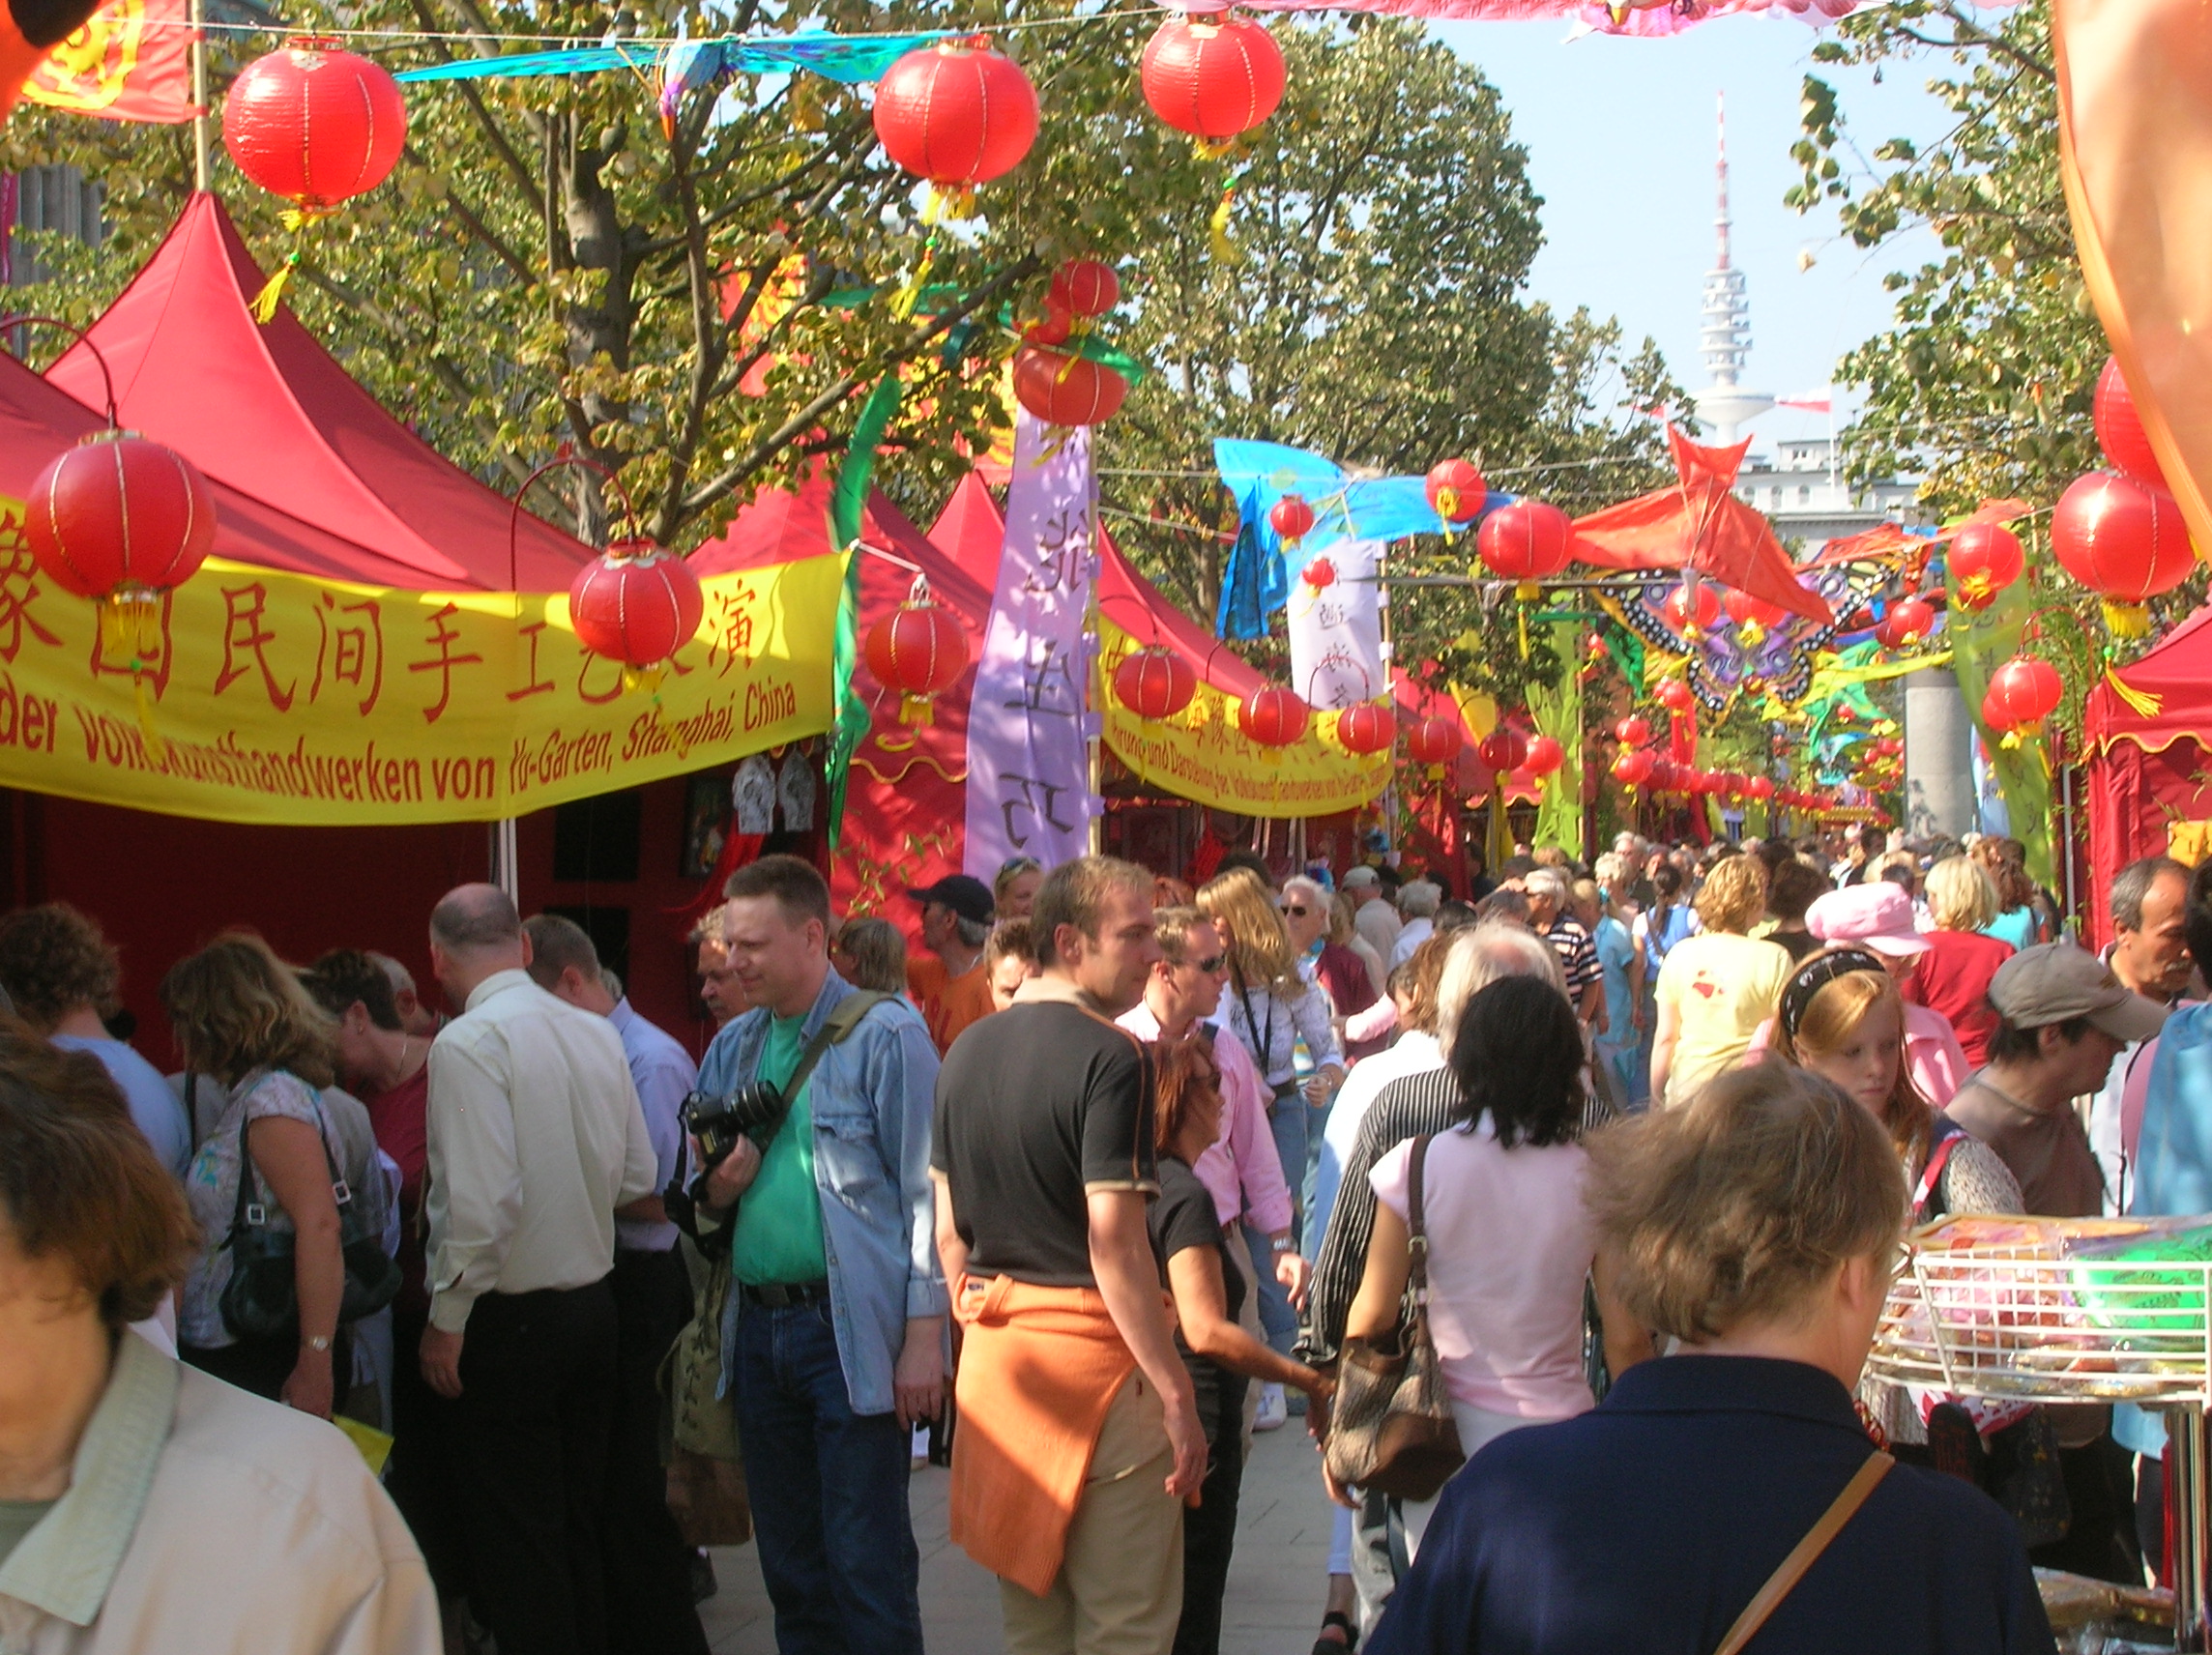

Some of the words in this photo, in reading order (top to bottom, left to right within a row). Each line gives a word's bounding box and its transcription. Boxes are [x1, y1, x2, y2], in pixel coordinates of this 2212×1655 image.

[431, 754, 496, 800] von
[509, 728, 614, 795] Yu-Garten,
[743, 675, 797, 733] China
